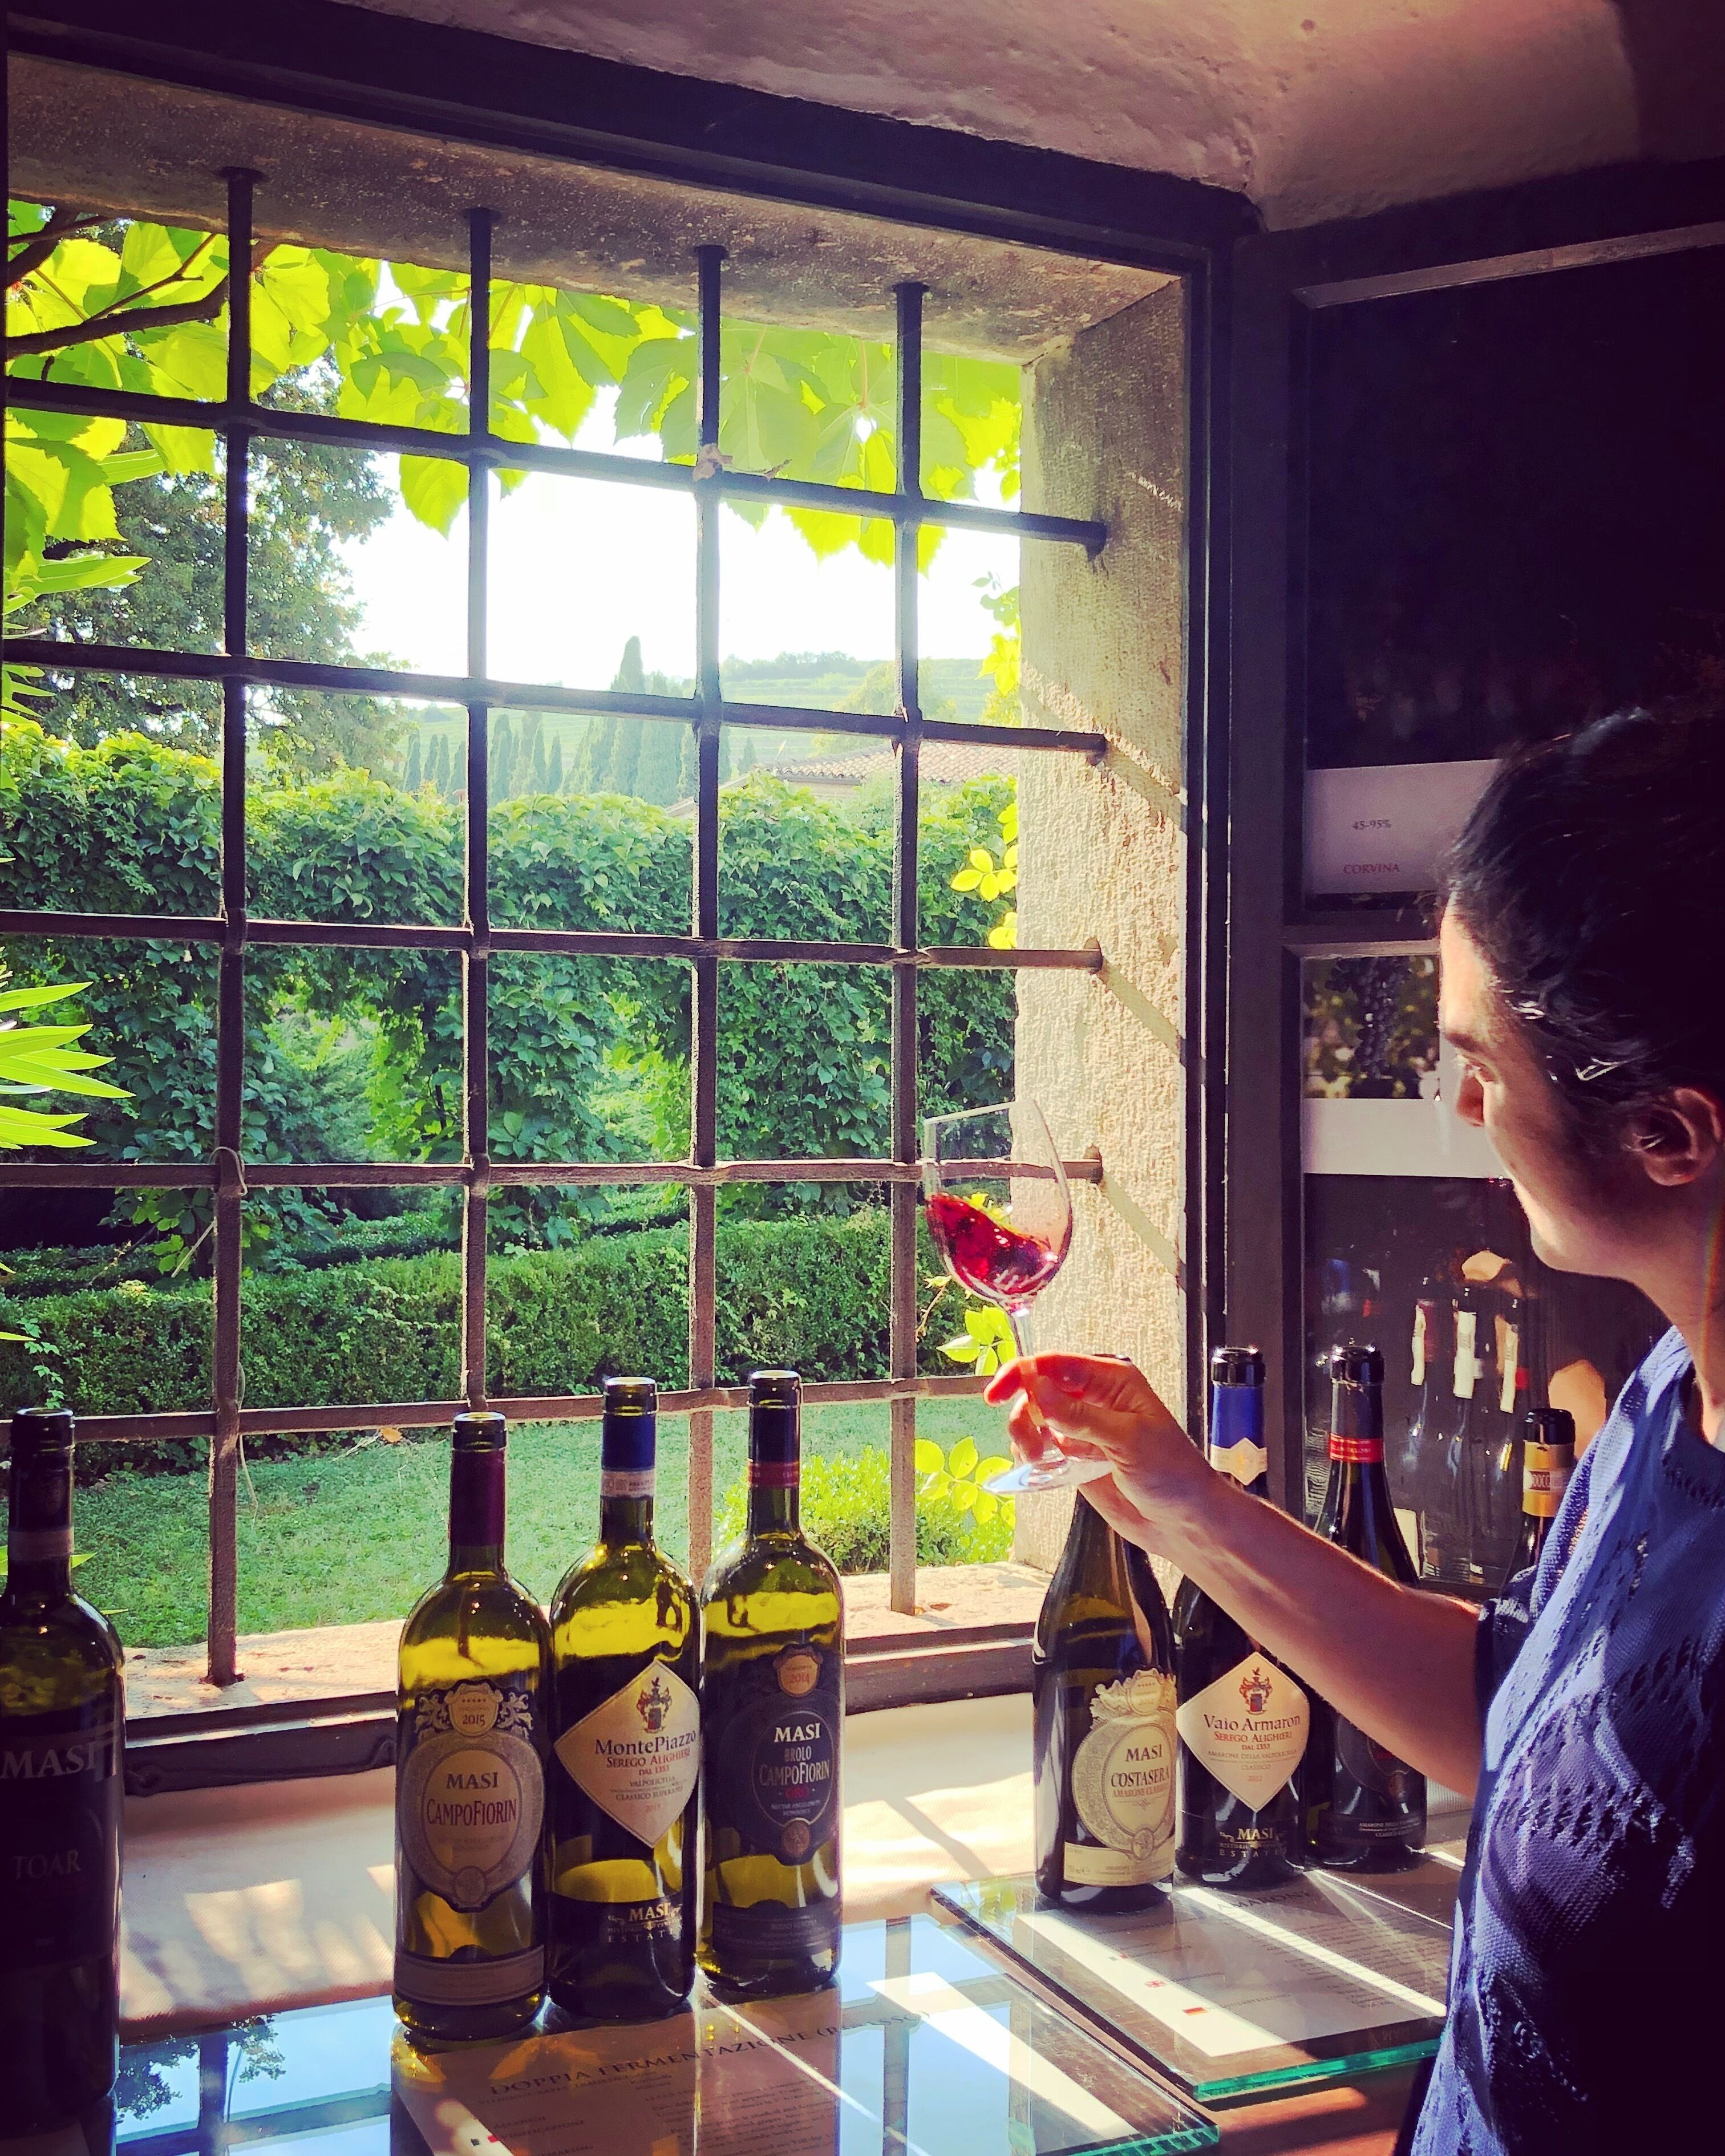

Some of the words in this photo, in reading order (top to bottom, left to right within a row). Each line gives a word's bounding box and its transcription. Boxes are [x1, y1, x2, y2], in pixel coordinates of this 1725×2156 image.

[1353, 819, 1392, 830] 45-95%
[1343, 862, 1400, 874] CORVINA
[462, 1714, 485, 1727] 2015
[1204, 1713, 1238, 1731] Vaio
[1242, 1715, 1300, 1731] Armaron
[774, 1723, 821, 1742] MASI
[1214, 1731, 1248, 1742] SEREGO
[1252, 1731, 1292, 1742] ALIGHIERI
[594, 1730, 696, 1755] MontePiazzo
[0, 1741, 96, 1780] MASI
[784, 1745, 812, 1762] BROLO
[1125, 1744, 1163, 1762] MASI
[446, 1772, 499, 1790] MASI
[1111, 1766, 1169, 1788] COSTASERA
[1237, 1827, 1274, 1840] MASI
[11, 1849, 82, 1881] TOAR
[629, 1902, 671, 1922] MASI
[489, 2070, 590, 2094] DOPPIA
[598, 2031, 809, 2077] FERMENTAZIONE
